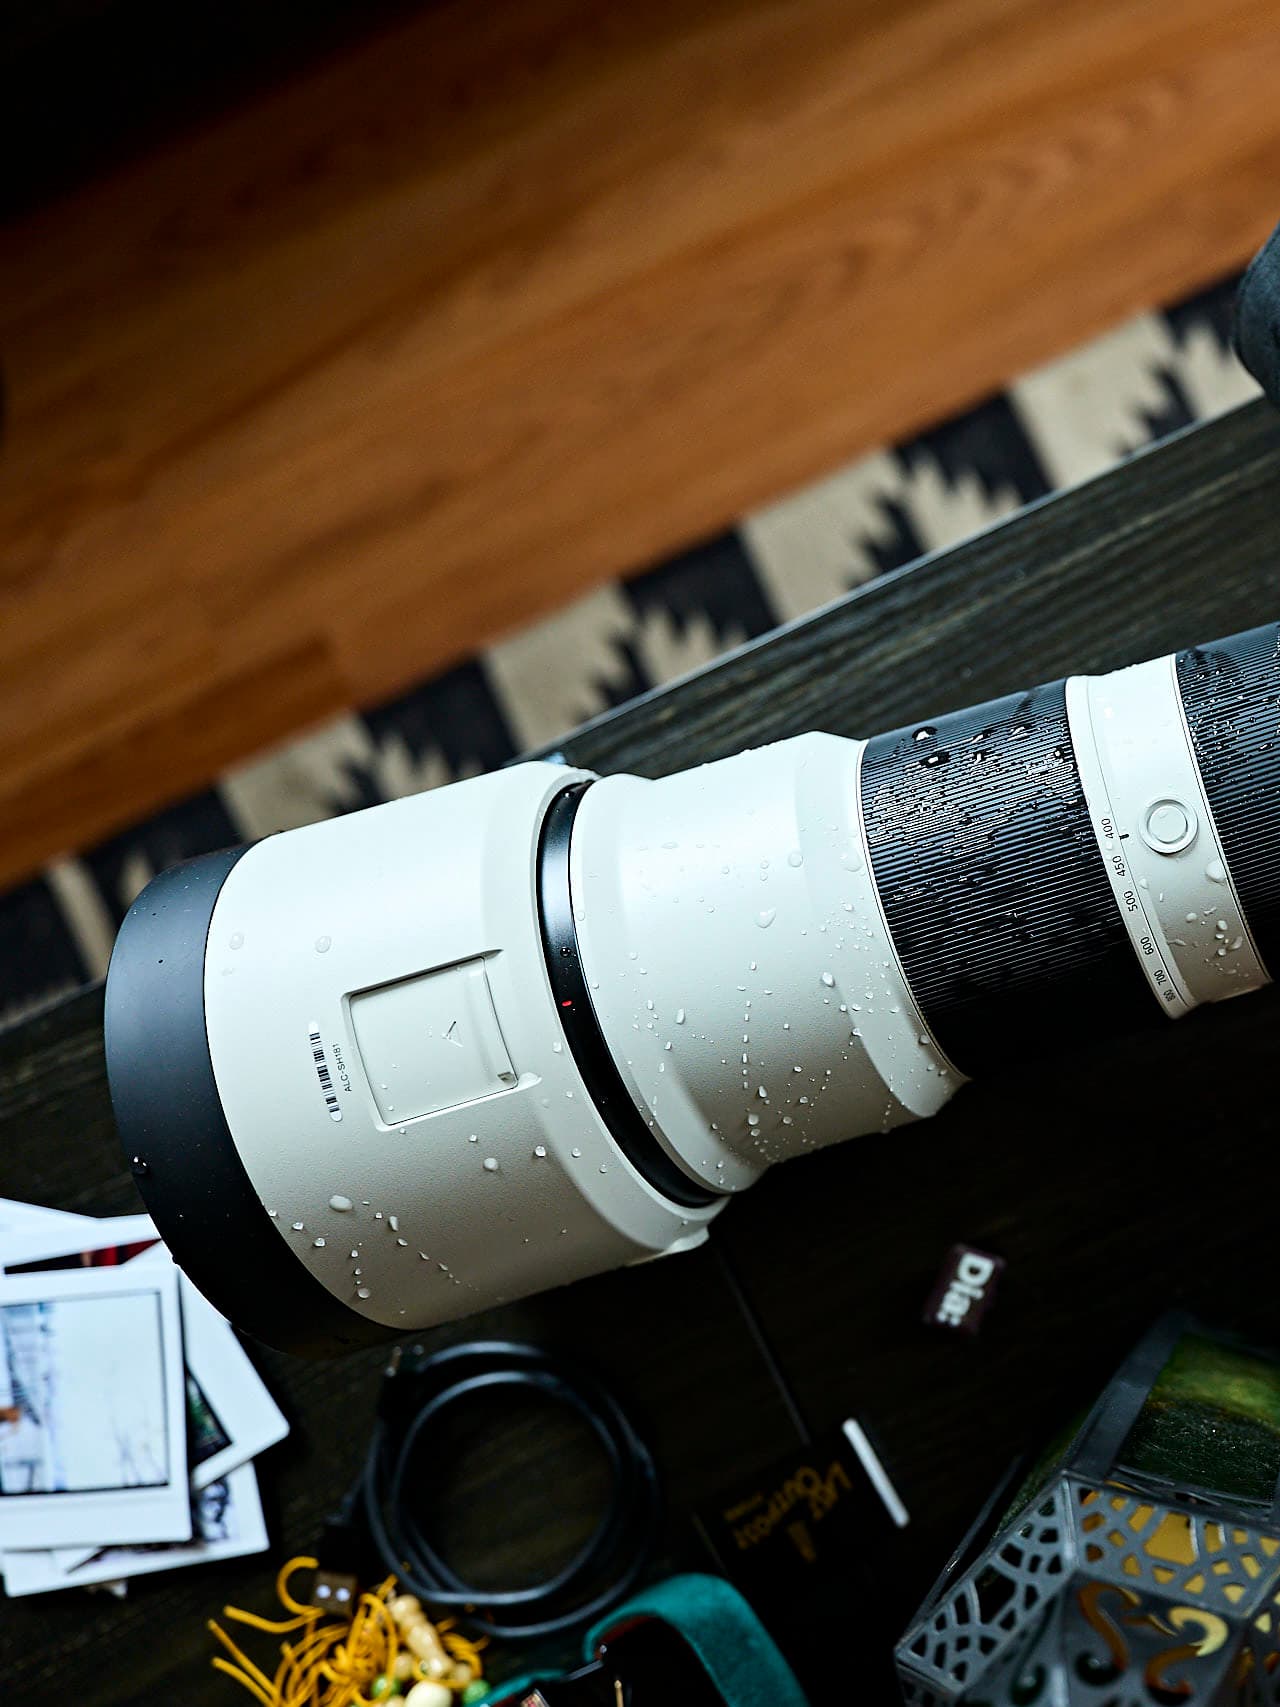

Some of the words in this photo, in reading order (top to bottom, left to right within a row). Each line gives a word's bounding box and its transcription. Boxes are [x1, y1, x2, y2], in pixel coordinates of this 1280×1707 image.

[1101, 818, 1114, 840] 400
[1112, 855, 1126, 878] 450
[1124, 890, 1138, 912] 500
[1140, 936, 1154, 956] 600
[1154, 969, 1167, 986] 700
[332, 1042, 353, 1093] ALC-SH181
